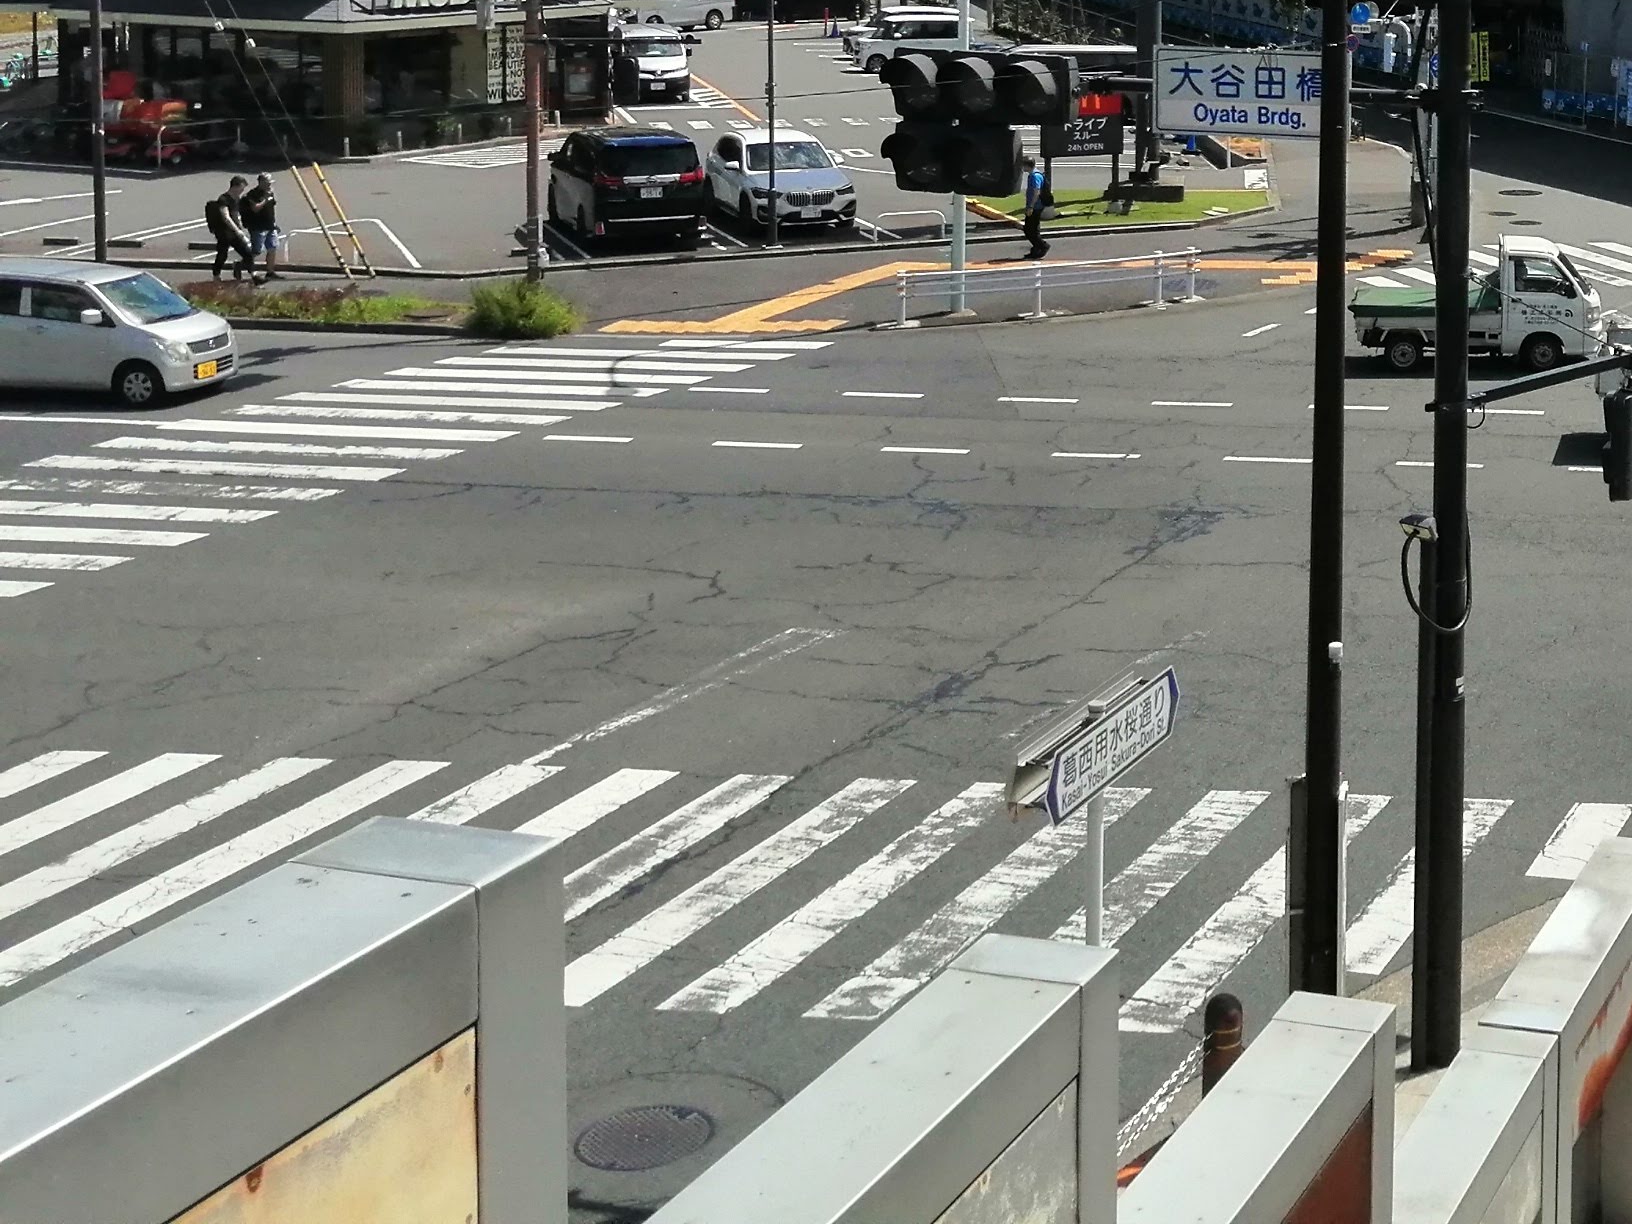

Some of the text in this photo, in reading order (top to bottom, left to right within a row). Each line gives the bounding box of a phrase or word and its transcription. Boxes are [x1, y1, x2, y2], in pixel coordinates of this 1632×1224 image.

[1193, 103, 1306, 129] Oyata Brdg.
[1067, 143, 1104, 152] 24h OPEN
[1073, 131, 1099, 140] スルー
[1062, 686, 1165, 788] 葛西用水桜通り
[1061, 762, 1109, 812] Kasai-Yosui
